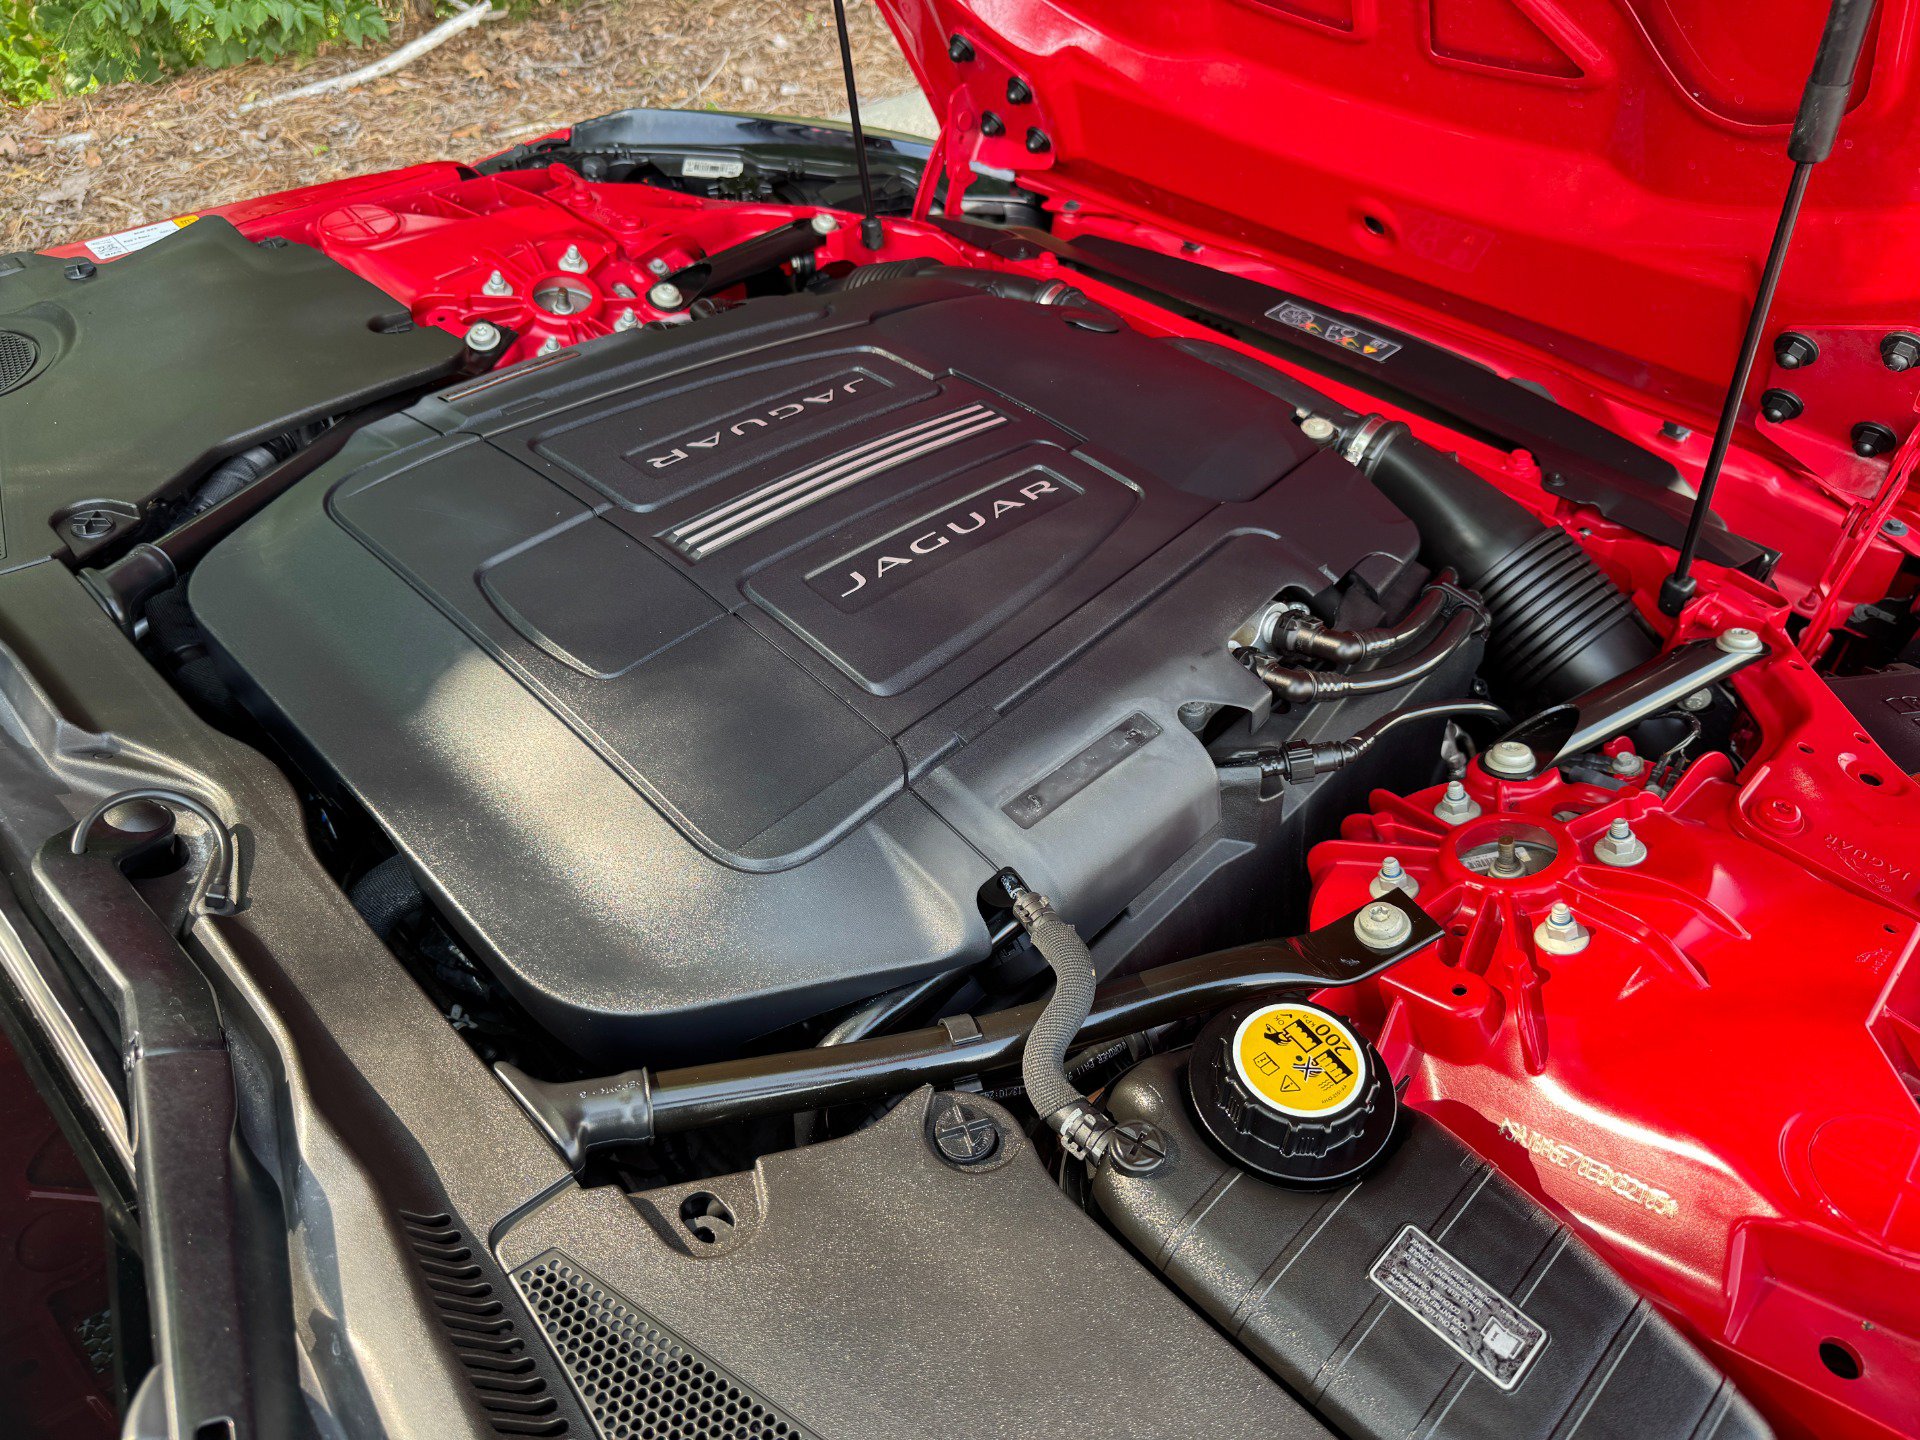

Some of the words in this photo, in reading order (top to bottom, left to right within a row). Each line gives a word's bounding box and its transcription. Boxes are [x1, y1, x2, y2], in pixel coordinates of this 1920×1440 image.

[646, 377, 864, 469] JAGUAR
[840, 480, 1060, 598] JAGUAR
[1824, 833, 1911, 881] JAGUAR
[1274, 1015, 1285, 1026] OK
[1315, 1023, 1352, 1057] 200
[1402, 1250, 1411, 1260] DE
[1407, 1245, 1431, 1266] LONGUE
[1409, 1237, 1434, 1258] ORANGE
[1409, 1256, 1430, 1275] FLUIDE
[1387, 1274, 1409, 1293] ENGINE
[1406, 1270, 1431, 1292] ORANGE
[1428, 1271, 1461, 1299] SEULEMENT
[1406, 1290, 1419, 1302] LIFE
[1429, 1288, 1461, 1314] COLOURED
[1458, 1295, 1481, 1315] UTILISE
[1417, 1299, 1435, 1315] LONG
[1433, 1312, 1450, 1327] ONLY
[1439, 1306, 1468, 1331] COOLANT
[1448, 1324, 1461, 1336] USE
